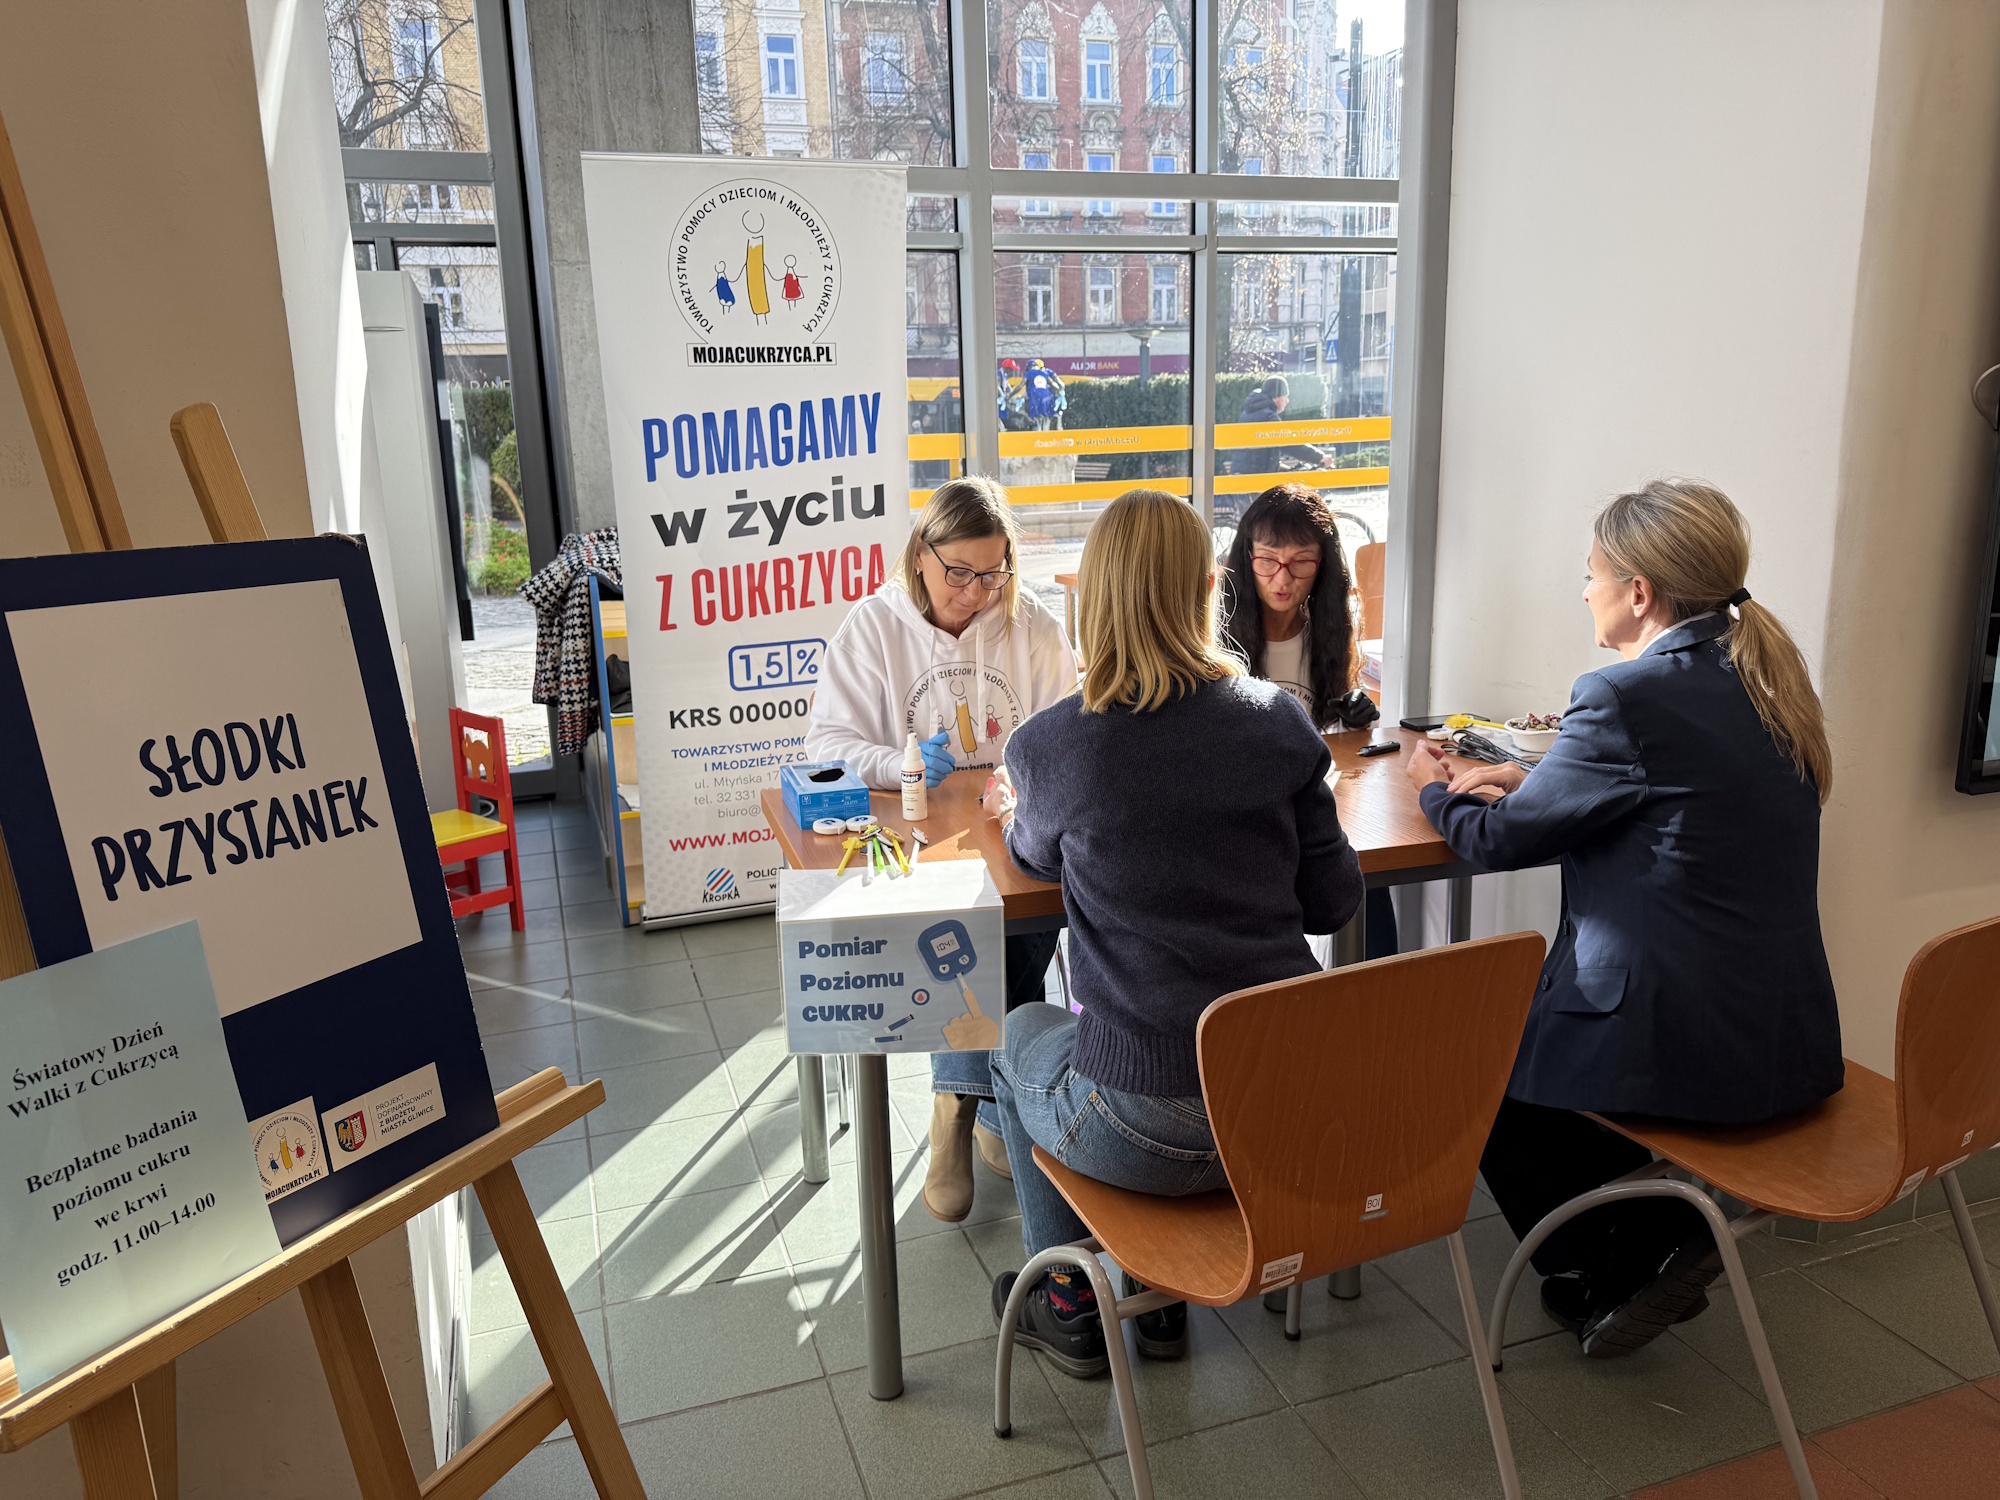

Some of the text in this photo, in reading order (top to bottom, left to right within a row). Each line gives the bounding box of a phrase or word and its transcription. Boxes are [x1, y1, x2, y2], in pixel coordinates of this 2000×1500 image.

[677, 187, 834, 334] TOWARZYSTWO POMOCY DZIECIOM I MŁODZIEŻY Z CUKRZYCĄ
[692, 346, 833, 364] MOJACUKRZYCA.PL
[1097, 360, 1120, 370] BANK
[642, 392, 881, 482] POMAGAMY
[650, 475, 885, 547] w życiu
[655, 574, 677, 631] Z
[937, 667, 972, 680] ZIECIOM
[669, 707, 722, 729] KRS
[139, 713, 306, 797] SŁODKI
[671, 740, 771, 759] TOWARZYSTWO
[704, 763, 708, 772] I
[711, 754, 783, 772] MŁODZIEŻY
[785, 754, 794, 763] Z
[694, 780, 709, 790] ul.
[714, 774, 763, 790] Młyńska
[766, 770, 780, 781] 17
[694, 790, 756, 805] tel. 32 331
[718, 805, 761, 818] biuro@
[91, 776, 378, 901] PRZYSTANEK
[702, 886, 740, 904] KROPKA
[798, 936, 888, 959] Pomiar
[936, 940, 951, 952] 104
[800, 970, 904, 992] Poziomu
[802, 1003, 884, 1023] CUKRU
[12, 1021, 164, 1091] Światowy Dzień
[6, 1044, 180, 1119] Walki z Cukrzycą
[375, 1093, 404, 1112] PROJEKT
[377, 1088, 433, 1120] DOFINANSOWANY
[381, 1105, 435, 1135] MIASTA GLIWICE
[385, 1105, 416, 1125] BUDŻETU
[25, 1110, 198, 1194] Bezpłatne badania
[51, 1144, 191, 1221] poziomu cukru
[94, 1183, 168, 1229] we krwi
[57, 1252, 108, 1287] godz.
